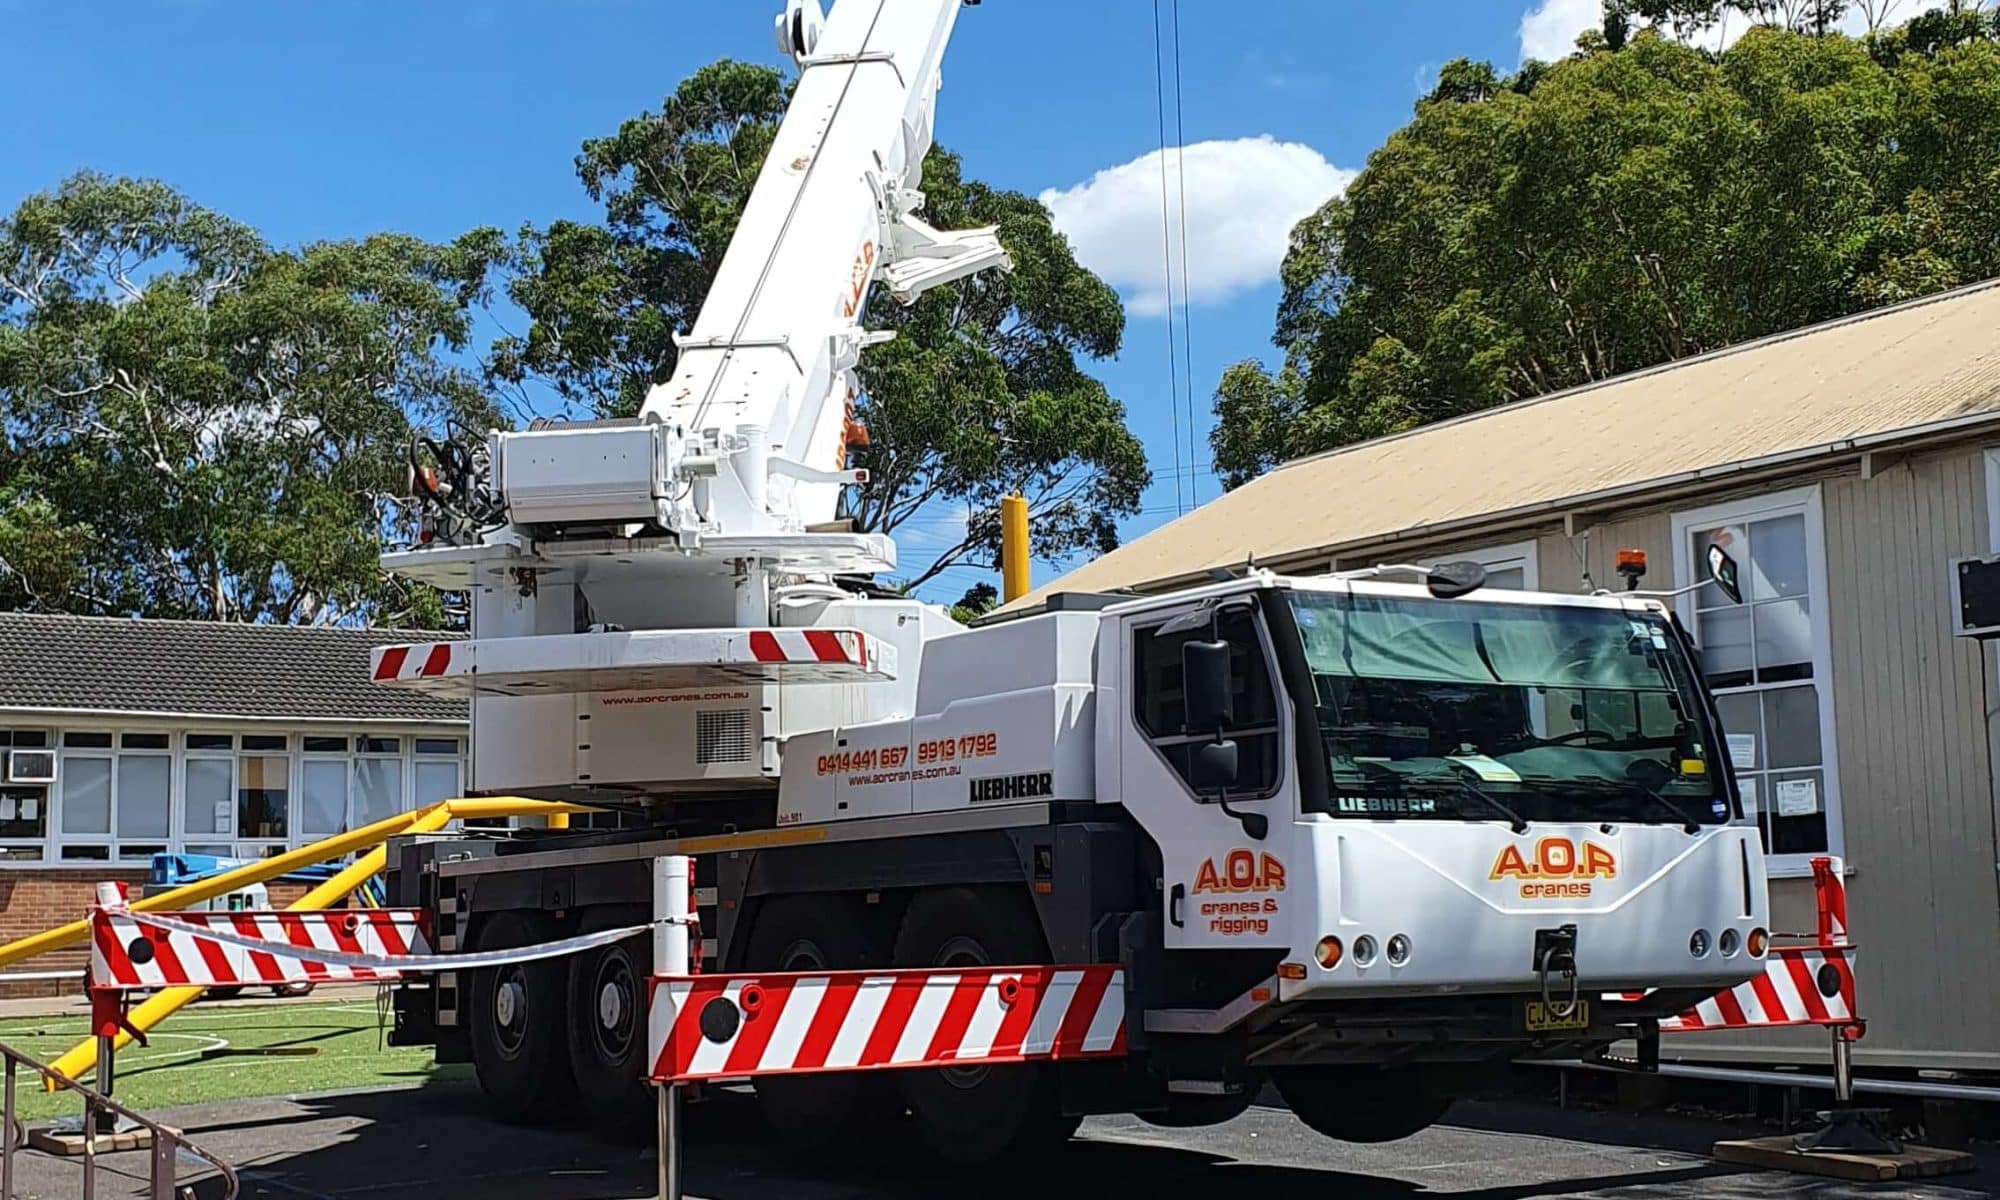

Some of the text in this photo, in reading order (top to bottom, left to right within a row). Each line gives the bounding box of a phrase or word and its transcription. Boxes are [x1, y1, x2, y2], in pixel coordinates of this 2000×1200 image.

[603, 692, 749, 705] www.aorcranes.com.au
[817, 733, 997, 775] 0414 441 667 9913 1792
[849, 765, 962, 786] www.aorcranes.com.au
[970, 772, 1052, 802] LIEBHERR
[1338, 797, 1436, 812] LIEBHERR
[1520, 882, 1592, 899] cranes
[1202, 898, 1278, 915] cranes &
[1210, 916, 1269, 934] rigging
